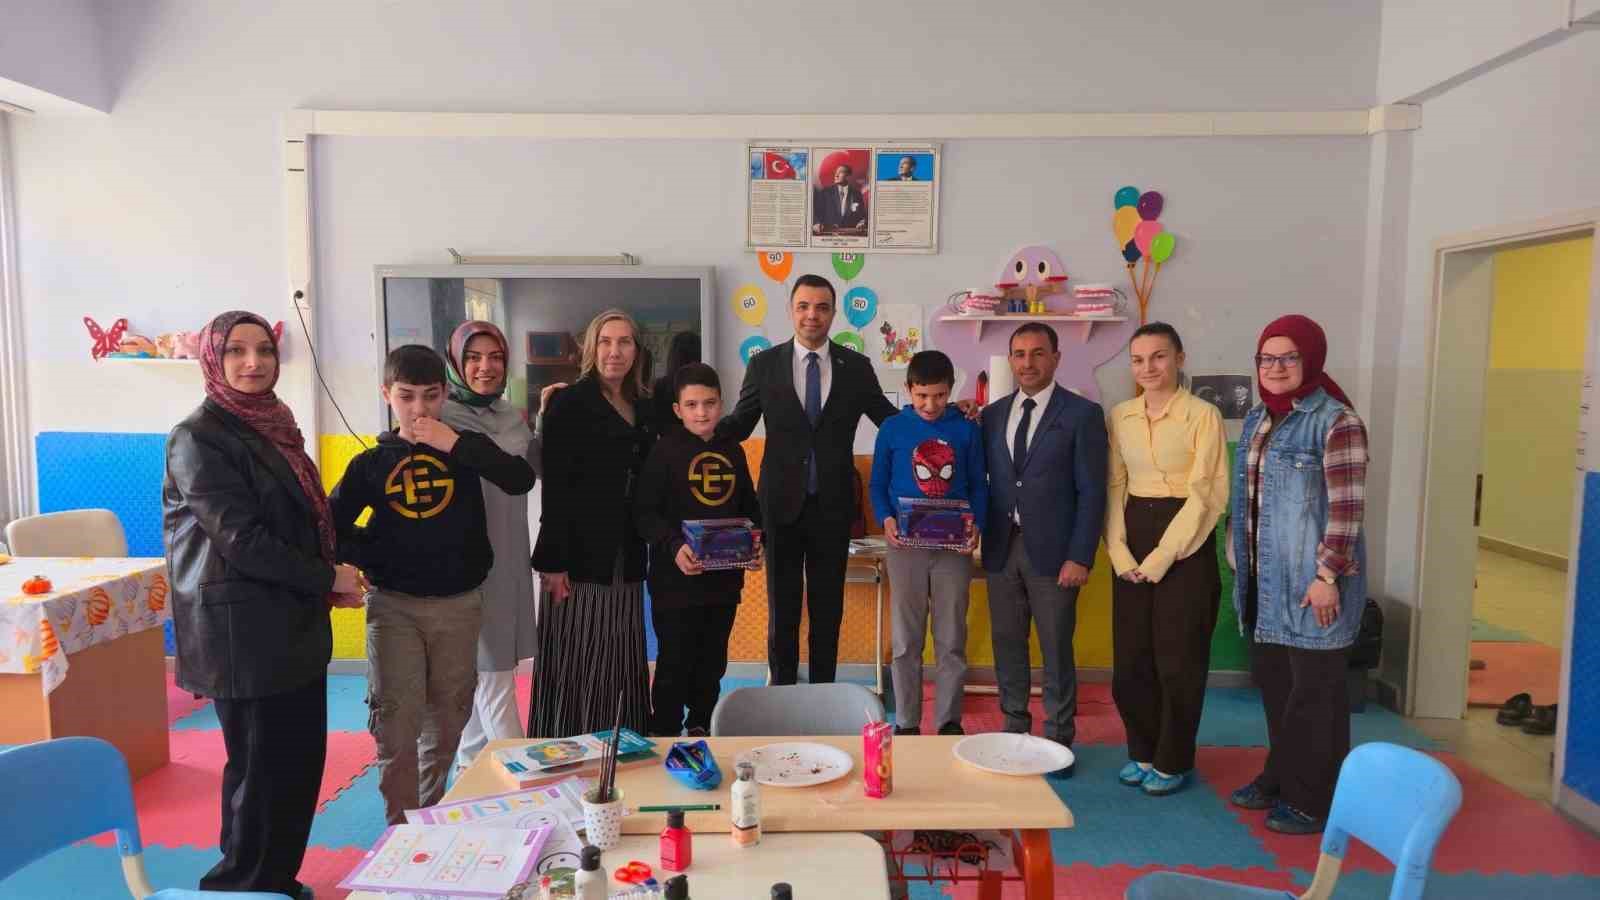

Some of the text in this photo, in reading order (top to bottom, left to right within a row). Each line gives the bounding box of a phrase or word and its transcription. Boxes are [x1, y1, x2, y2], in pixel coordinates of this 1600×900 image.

[769, 252, 782, 263] 90
[743, 298, 755, 309] 60
[853, 299, 866, 310] 80
